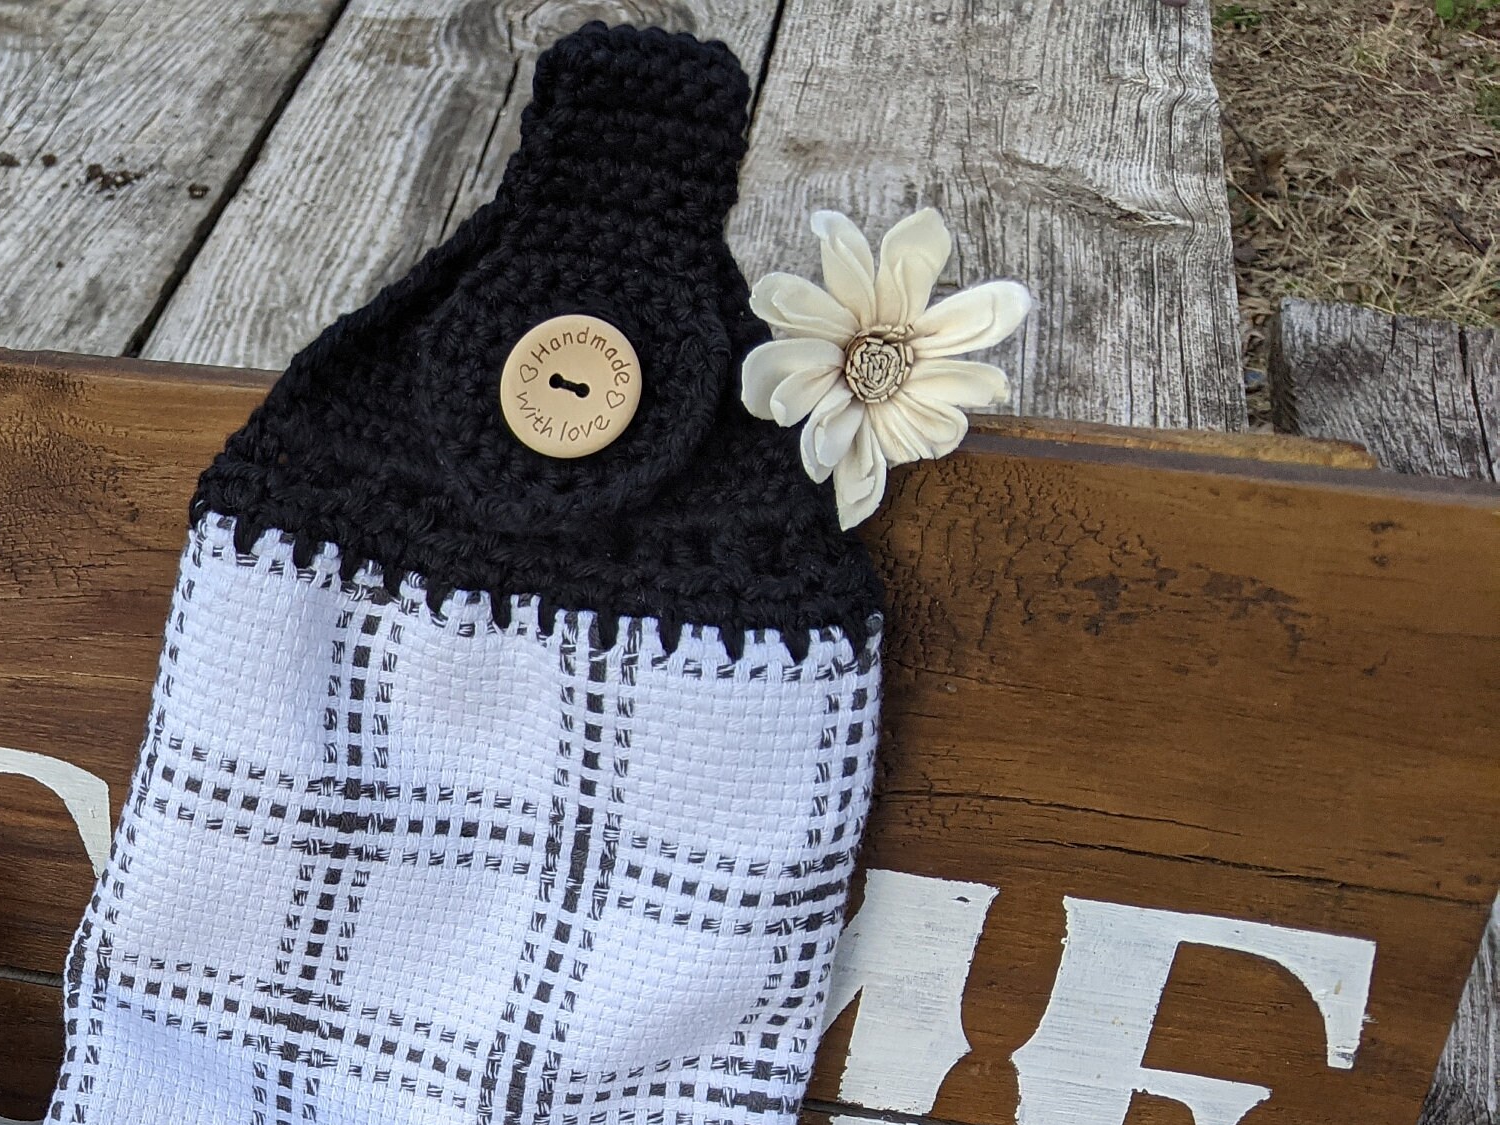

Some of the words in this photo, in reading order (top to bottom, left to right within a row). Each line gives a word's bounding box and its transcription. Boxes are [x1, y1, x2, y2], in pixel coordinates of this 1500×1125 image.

[530, 326, 632, 387] Handmade
[516, 391, 554, 438] with
[559, 414, 611, 442] love
